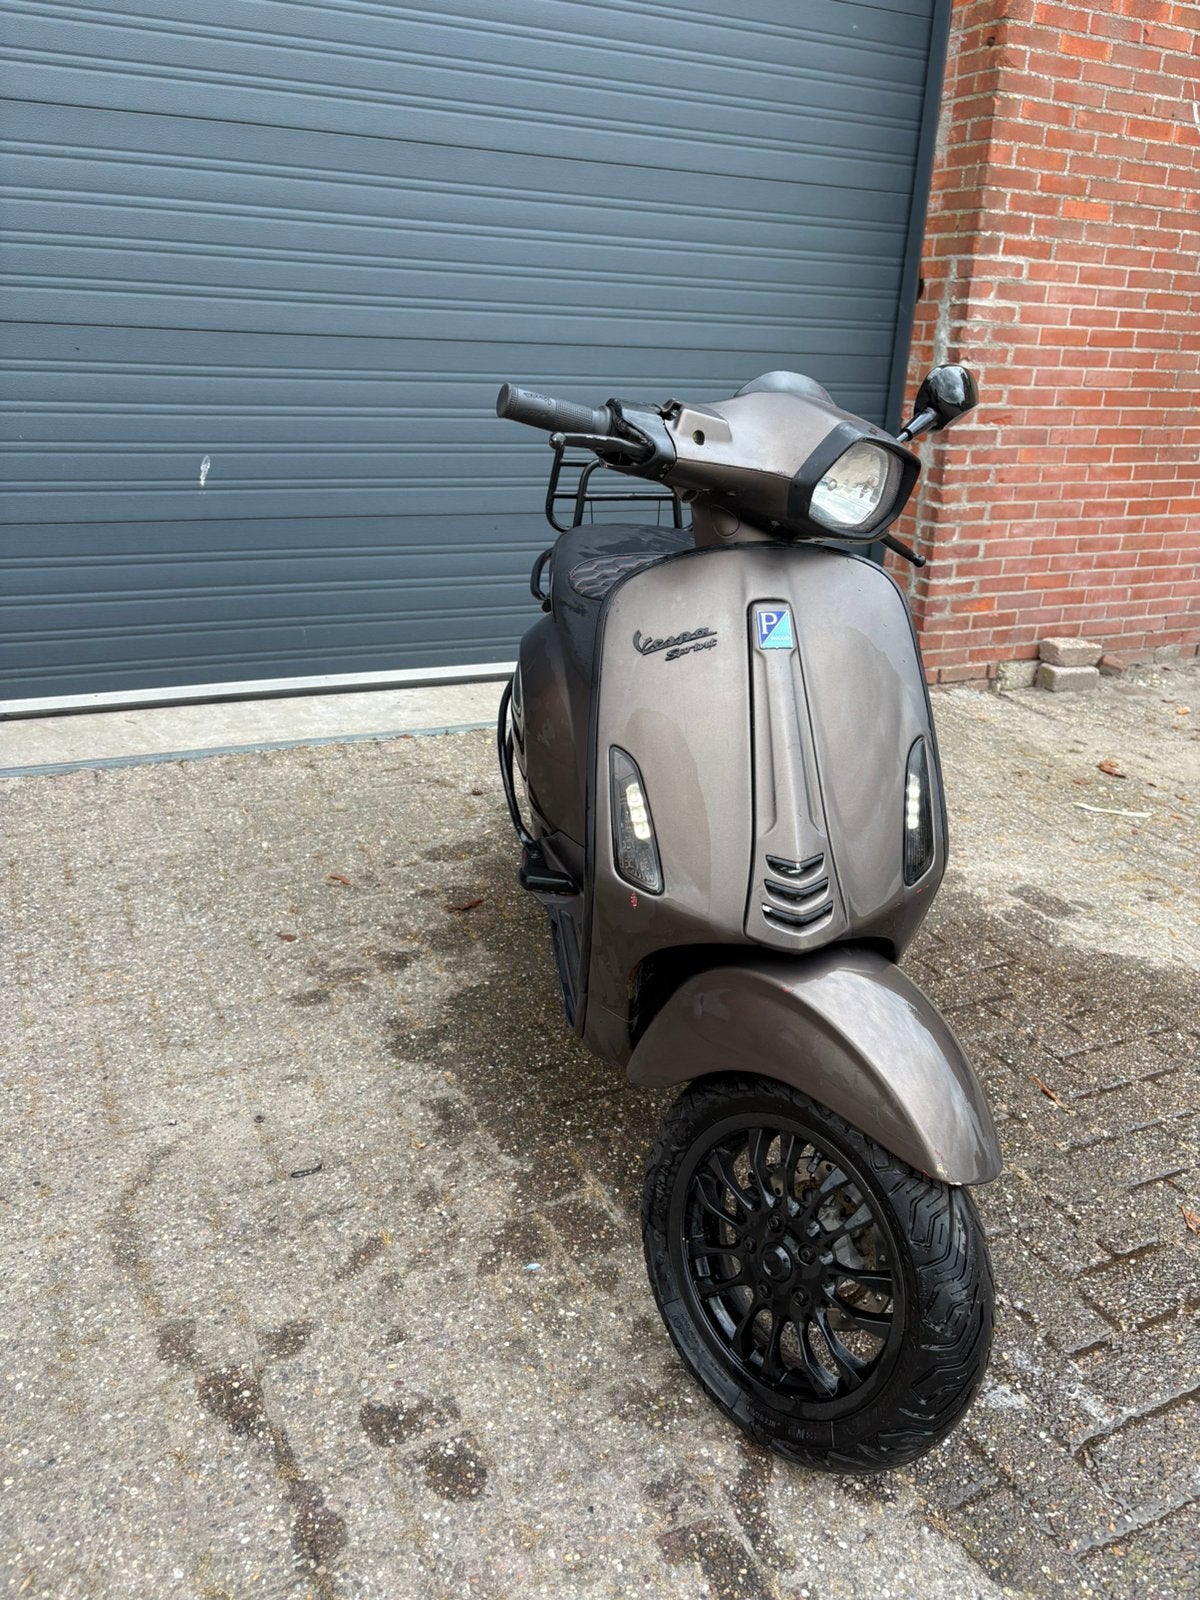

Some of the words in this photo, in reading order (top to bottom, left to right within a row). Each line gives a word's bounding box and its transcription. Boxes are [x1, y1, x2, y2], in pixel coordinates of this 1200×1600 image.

[760, 612, 777, 634] P
[632, 627, 717, 656] Vespa
[665, 638, 718, 661] Sprint
